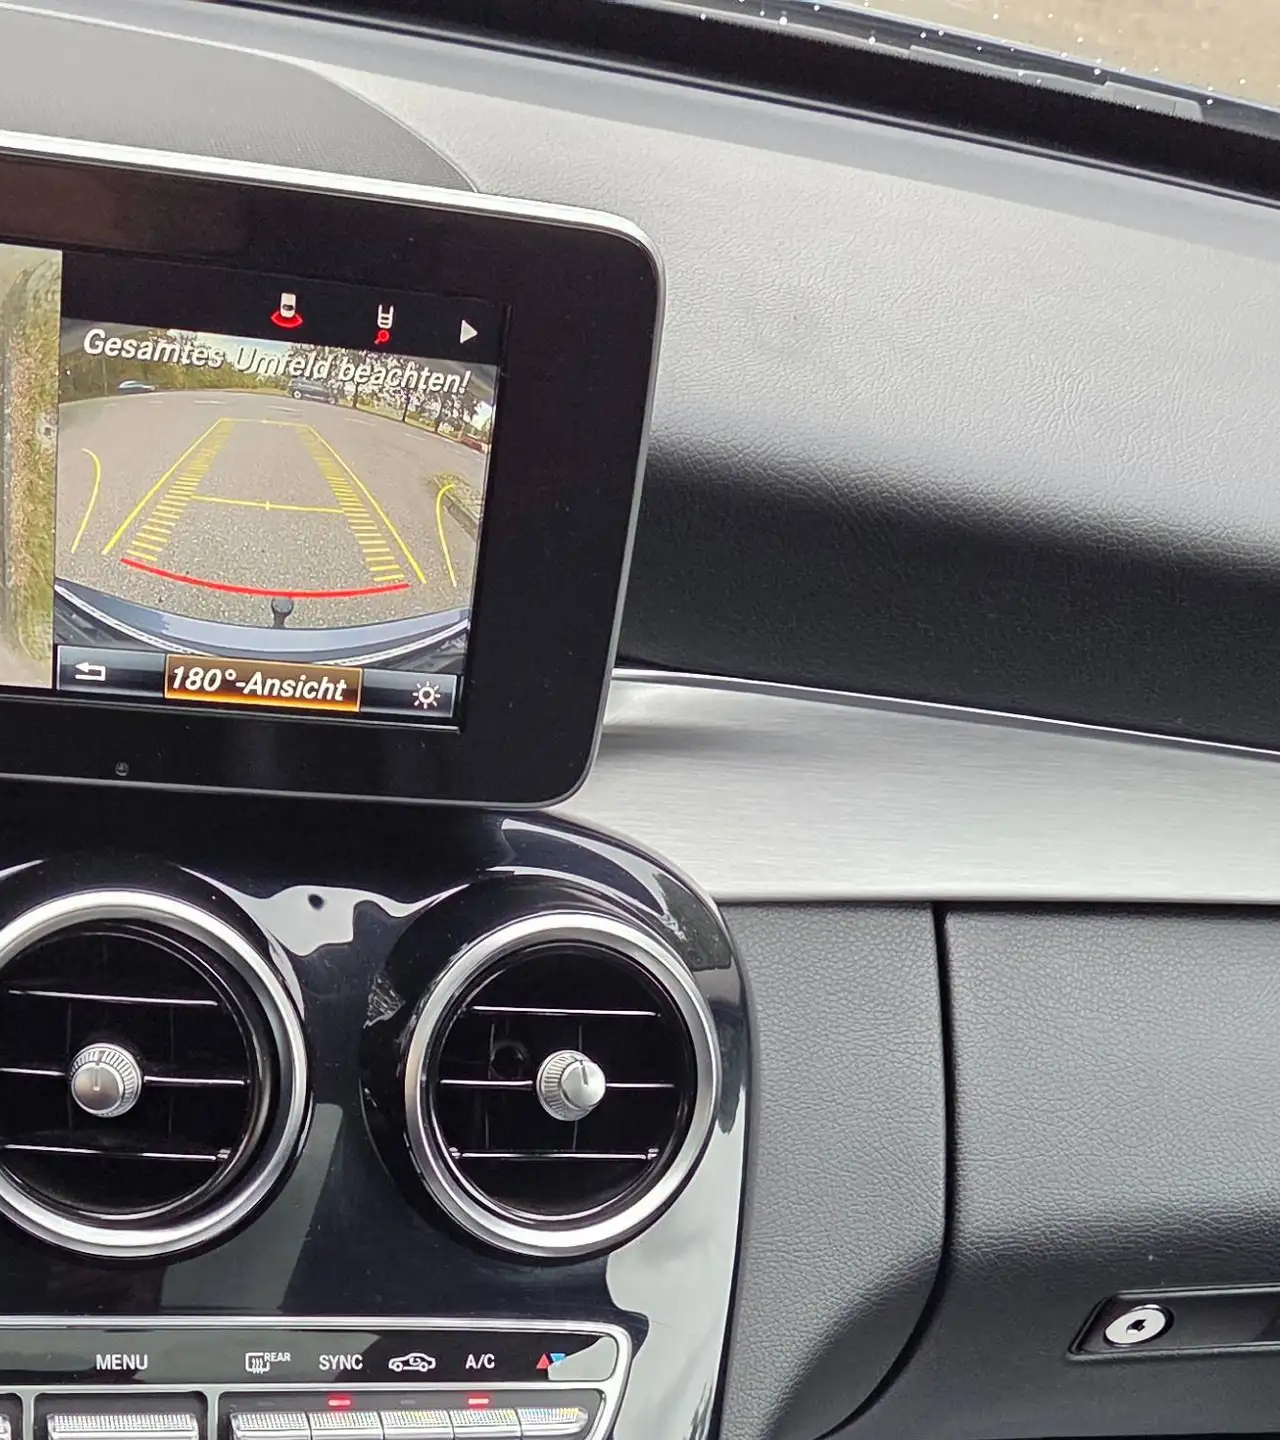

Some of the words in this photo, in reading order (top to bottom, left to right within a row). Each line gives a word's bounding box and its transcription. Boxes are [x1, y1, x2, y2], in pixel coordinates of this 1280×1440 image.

[83, 328, 223, 368] Gesamtes
[236, 346, 330, 379] Umfeld
[339, 357, 471, 394] beachten!
[173, 665, 348, 701] 180°-Ansicht
[96, 1353, 149, 1371] MENU
[264, 1351, 291, 1364] REAR
[318, 1353, 364, 1371] SYNC
[464, 1352, 495, 1371] A/C
